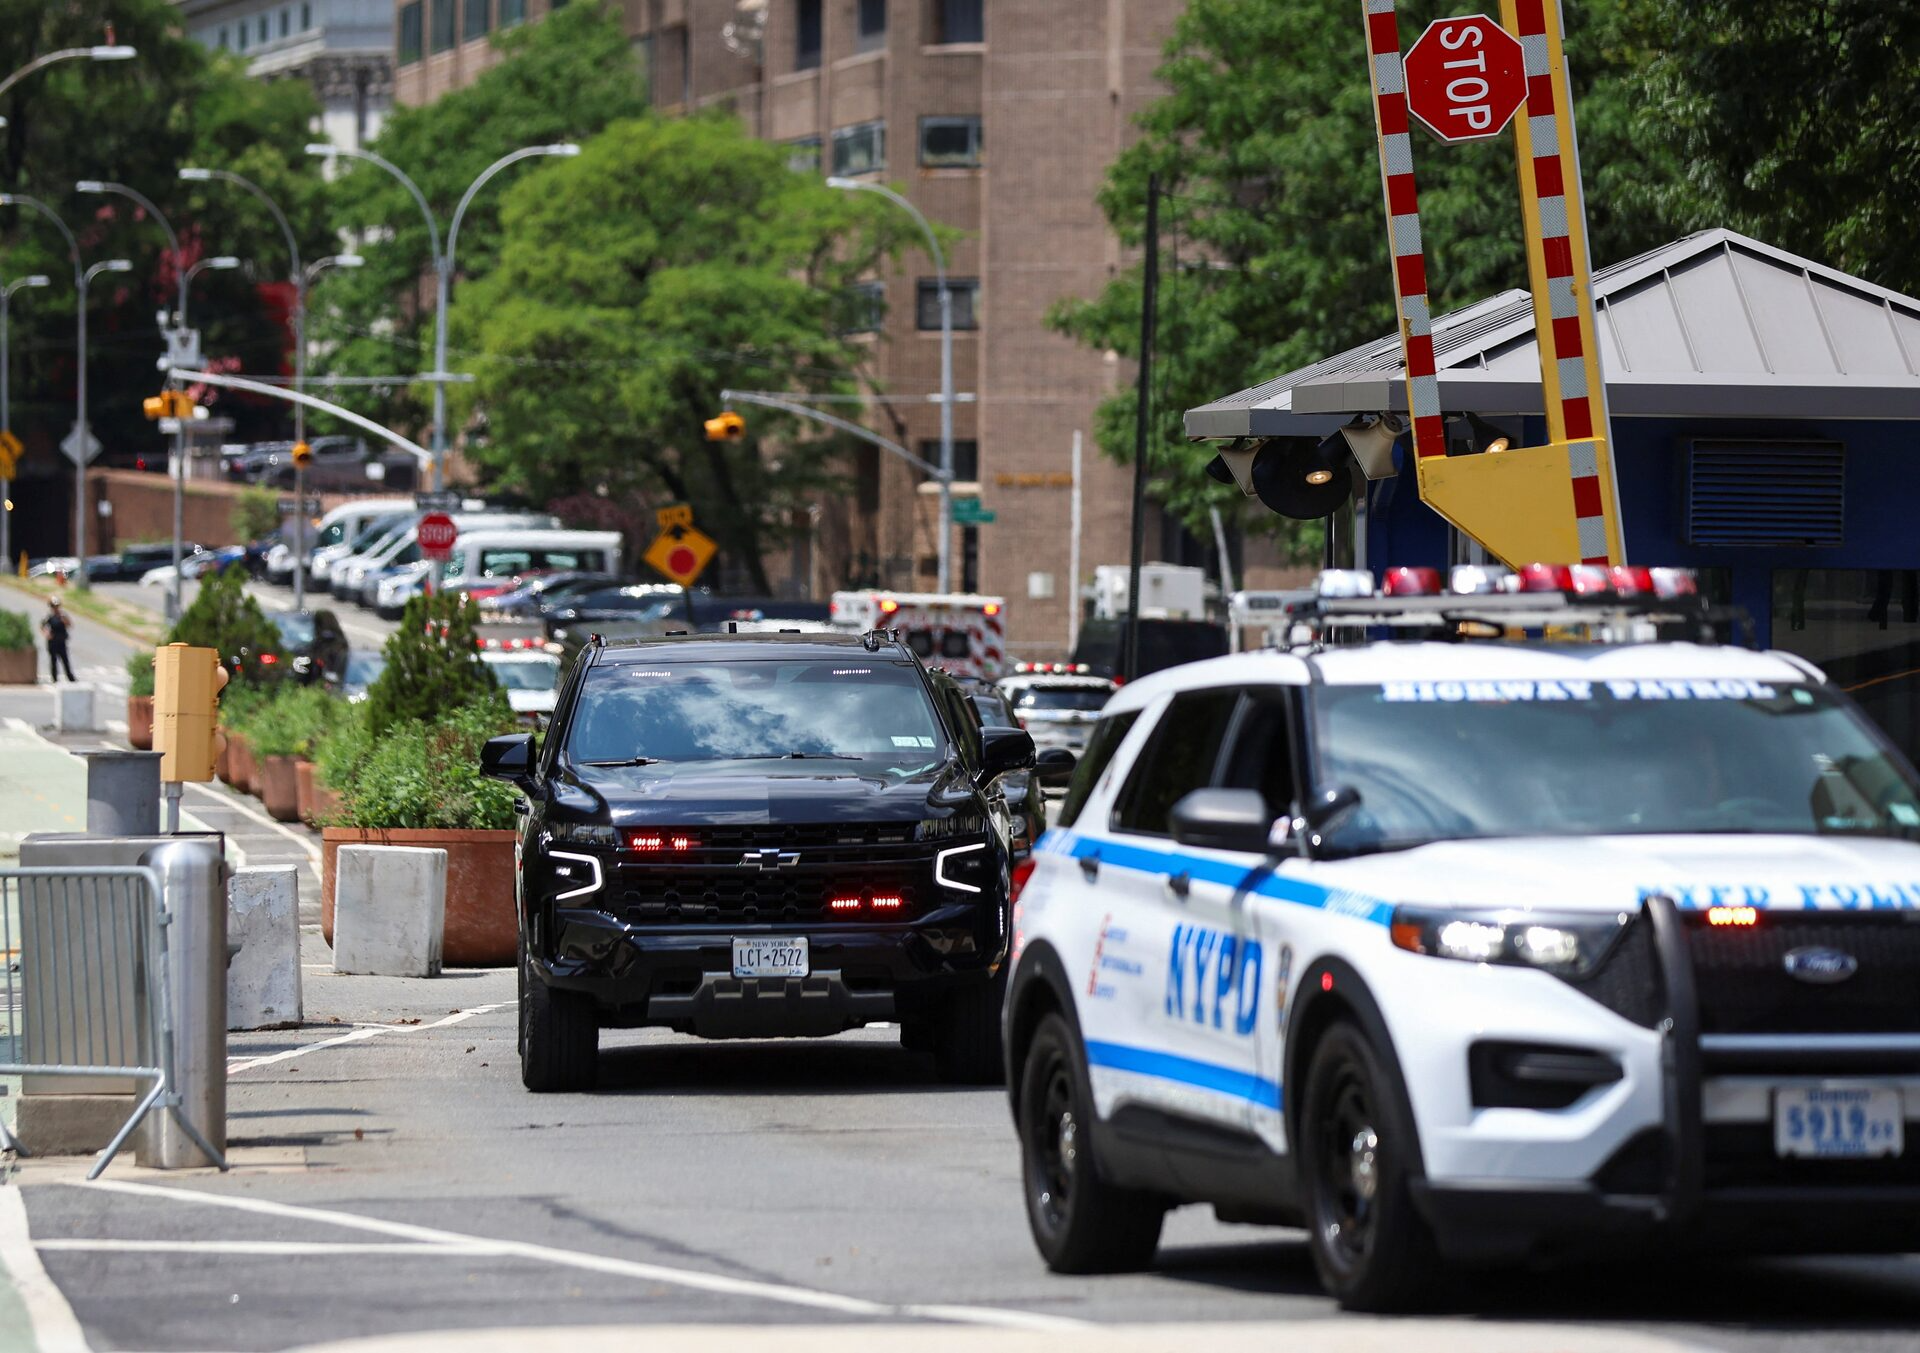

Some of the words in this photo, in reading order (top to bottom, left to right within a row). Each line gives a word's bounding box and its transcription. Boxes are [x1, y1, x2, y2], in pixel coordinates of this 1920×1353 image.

[1440, 26, 1492, 130] STOP
[422, 525, 453, 543] STOP
[1381, 681, 1592, 701] HIGHWAY
[1605, 681, 1776, 700] PATROL
[752, 940, 768, 948] NEW
[771, 940, 789, 948] YORK
[740, 949, 761, 967] LCT
[772, 949, 802, 967] 2522
[1164, 922, 1262, 1036] NYPD
[1787, 1105, 1865, 1140] 5919
